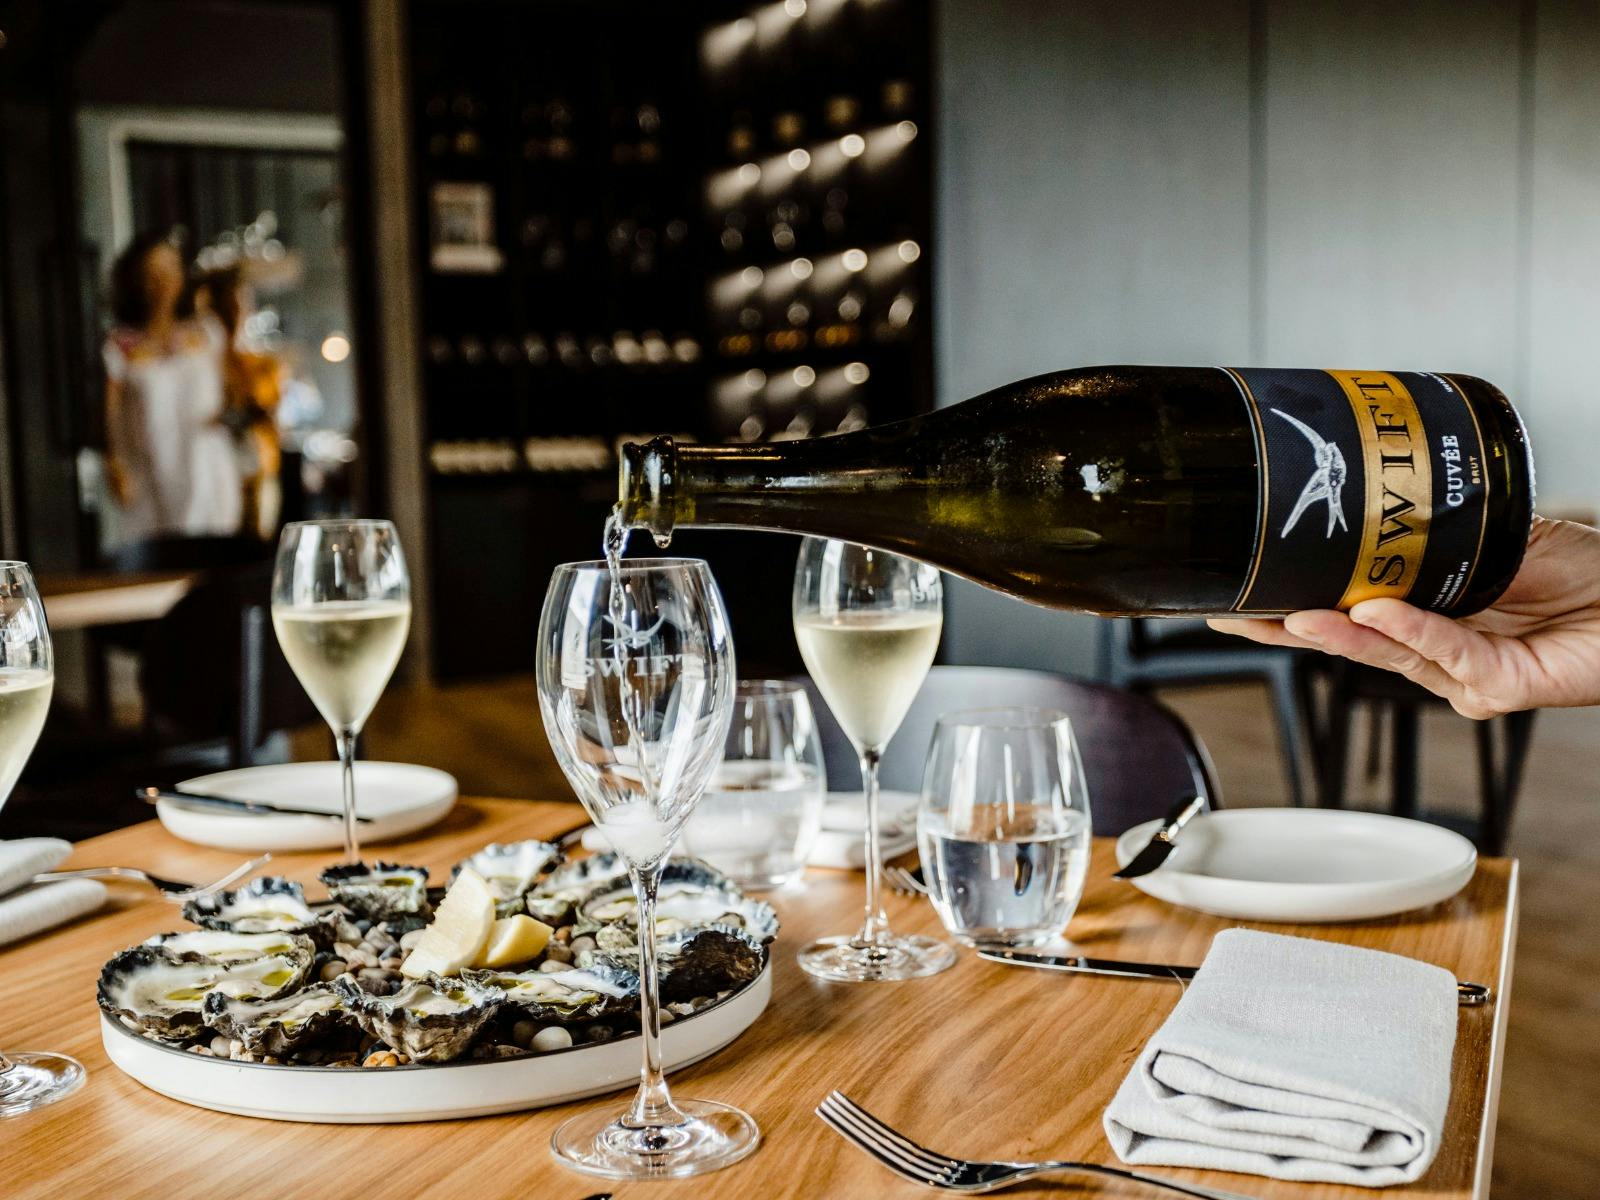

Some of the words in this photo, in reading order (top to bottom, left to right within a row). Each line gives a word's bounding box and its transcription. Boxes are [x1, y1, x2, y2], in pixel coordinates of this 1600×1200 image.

[1351, 376, 1416, 586] SWIFT
[1440, 435, 1464, 507] CUVÉE
[1469, 455, 1481, 484] BRUT
